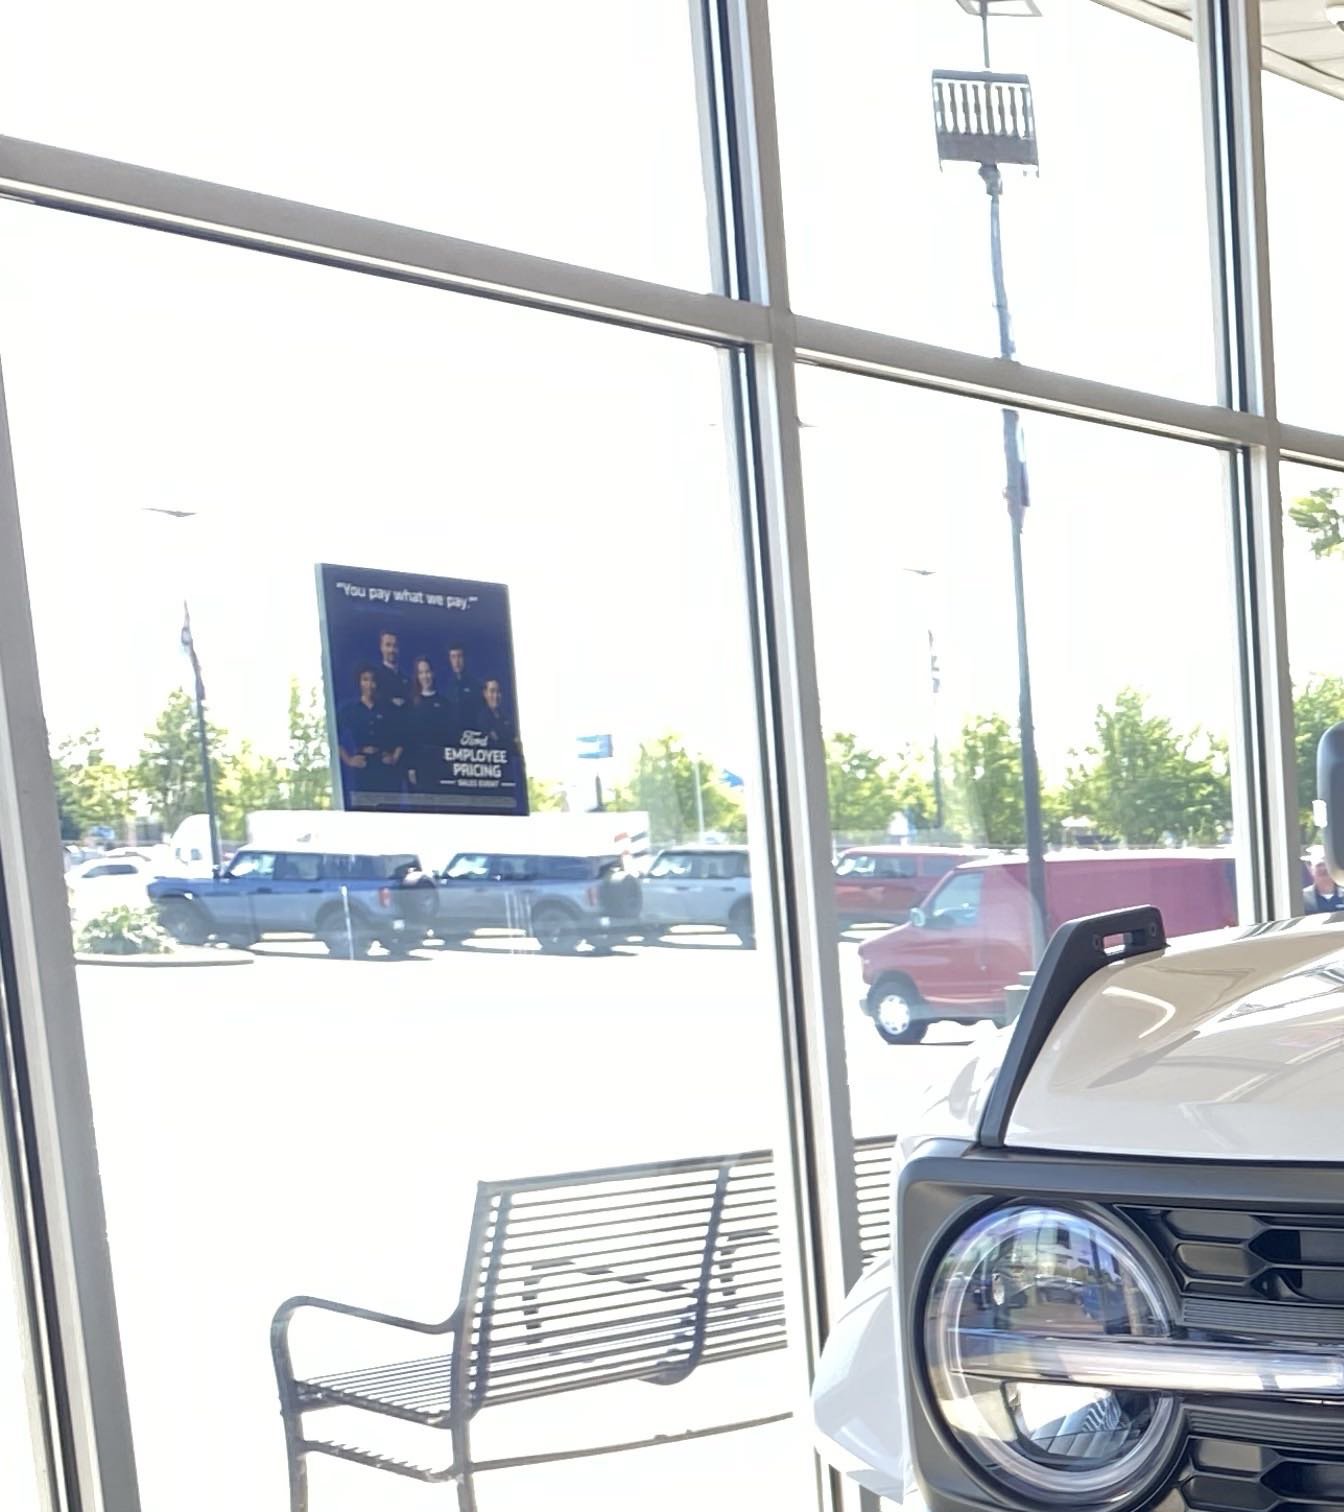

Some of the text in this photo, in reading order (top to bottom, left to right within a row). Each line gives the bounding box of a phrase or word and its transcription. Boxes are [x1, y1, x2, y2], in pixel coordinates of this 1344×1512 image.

[368, 588, 392, 603] pay
[393, 589, 424, 604] what
[425, 594, 444, 606] we
[460, 730, 488, 747] Ford
[444, 747, 508, 763] EMPLOYEE
[453, 763, 502, 778] PRICING
